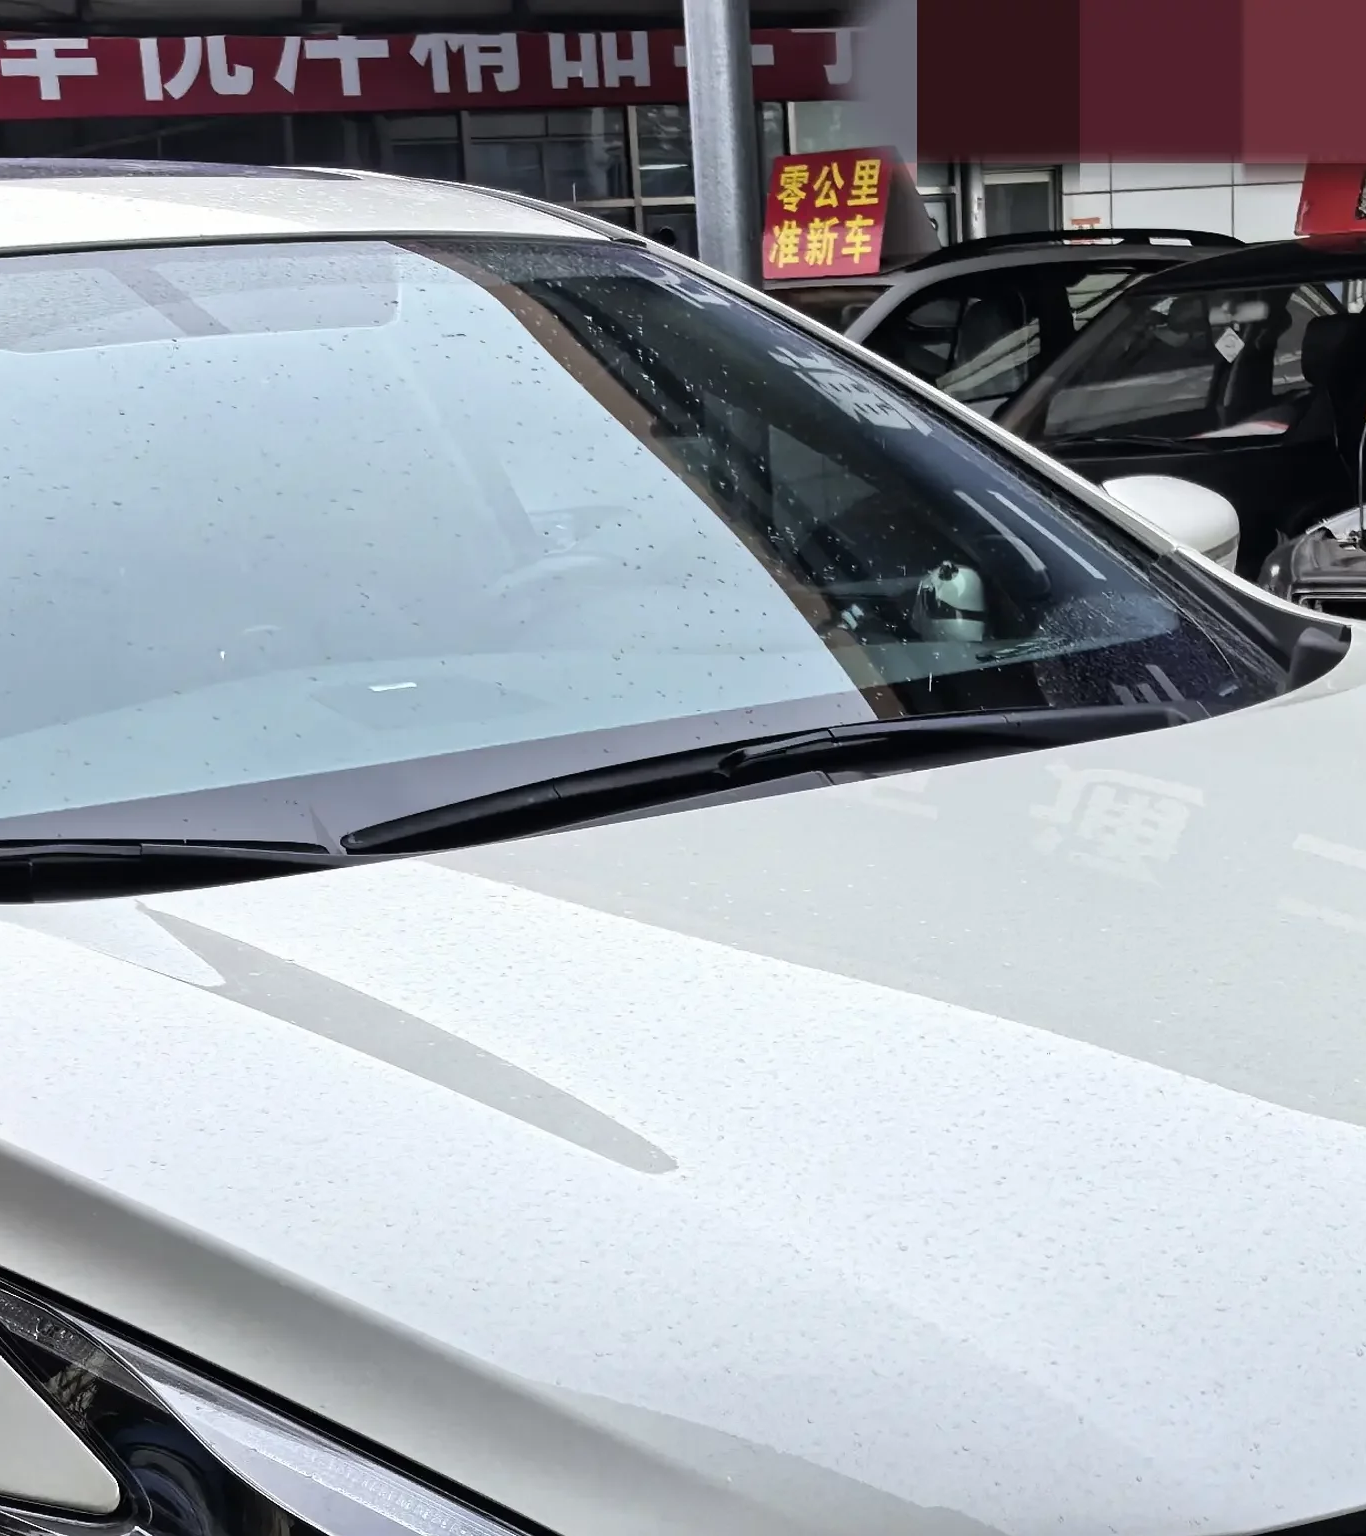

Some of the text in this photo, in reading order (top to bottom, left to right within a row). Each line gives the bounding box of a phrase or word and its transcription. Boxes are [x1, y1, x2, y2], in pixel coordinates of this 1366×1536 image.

[777, 158, 881, 212] 零公里
[769, 213, 875, 268] 准新车
